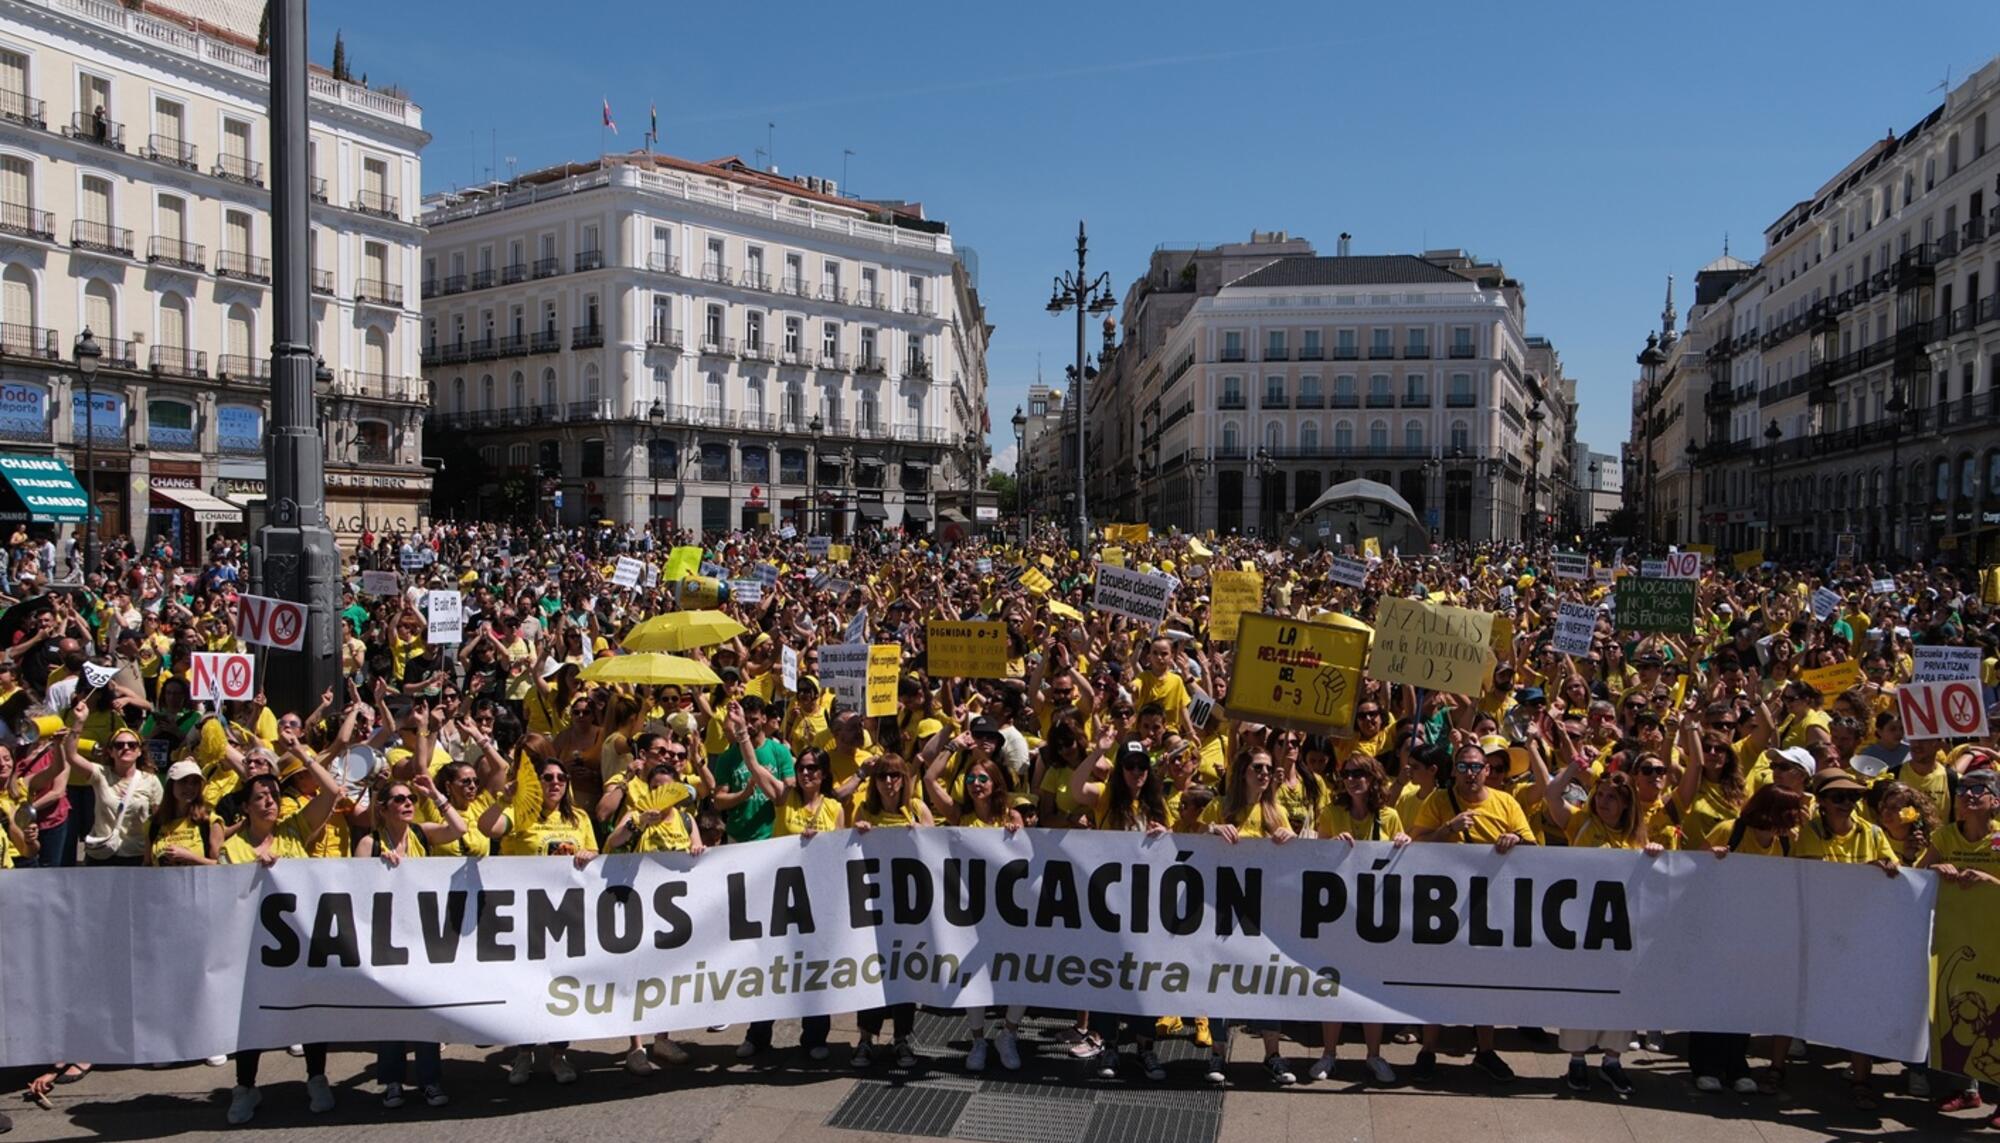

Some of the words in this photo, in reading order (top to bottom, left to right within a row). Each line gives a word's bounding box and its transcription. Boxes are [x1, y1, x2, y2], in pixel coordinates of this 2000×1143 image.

[73, 398, 104, 410] Ornge
[1, 459, 63, 471] CHANGE
[13, 478, 74, 489] TRANSFER
[151, 478, 196, 489] CHANGE
[27, 496, 88, 508] CAMBIO
[325, 515, 407, 534] RAGUAS
[1667, 553, 1697, 577] NO
[1099, 569, 1133, 593] Escuelas
[1133, 580, 1166, 601] clasistas
[1098, 590, 1125, 608] dividen
[1627, 598, 1645, 610] NO
[237, 596, 303, 645] NO
[1560, 603, 1595, 621] EDUCAR
[1640, 610, 1690, 626] FACTURAS
[1384, 601, 1483, 643] AZALEAS
[930, 627, 972, 638] DIGNIDAD
[1278, 626, 1297, 646] LA
[1915, 649, 1943, 658] Escuela
[1944, 651, 1949, 660] y
[1387, 654, 1406, 675] del
[1924, 661, 1970, 671] PRIVATIZAN
[193, 655, 251, 697] NO
[1915, 673, 1936, 682] PARA
[1272, 685, 1302, 705] 0-3
[1190, 699, 1211, 726] NO
[1899, 683, 1981, 735] NO
[260, 881, 694, 967] SALVEMOS
[727, 866, 815, 941] LA
[846, 851, 1263, 936] EDUCACIÓN
[1300, 859, 1632, 950] PÚBLICA
[546, 975, 615, 1016] Su
[632, 939, 972, 1021] privatización,
[991, 951, 1189, 993] nuestra
[1207, 954, 1341, 998] ruina
